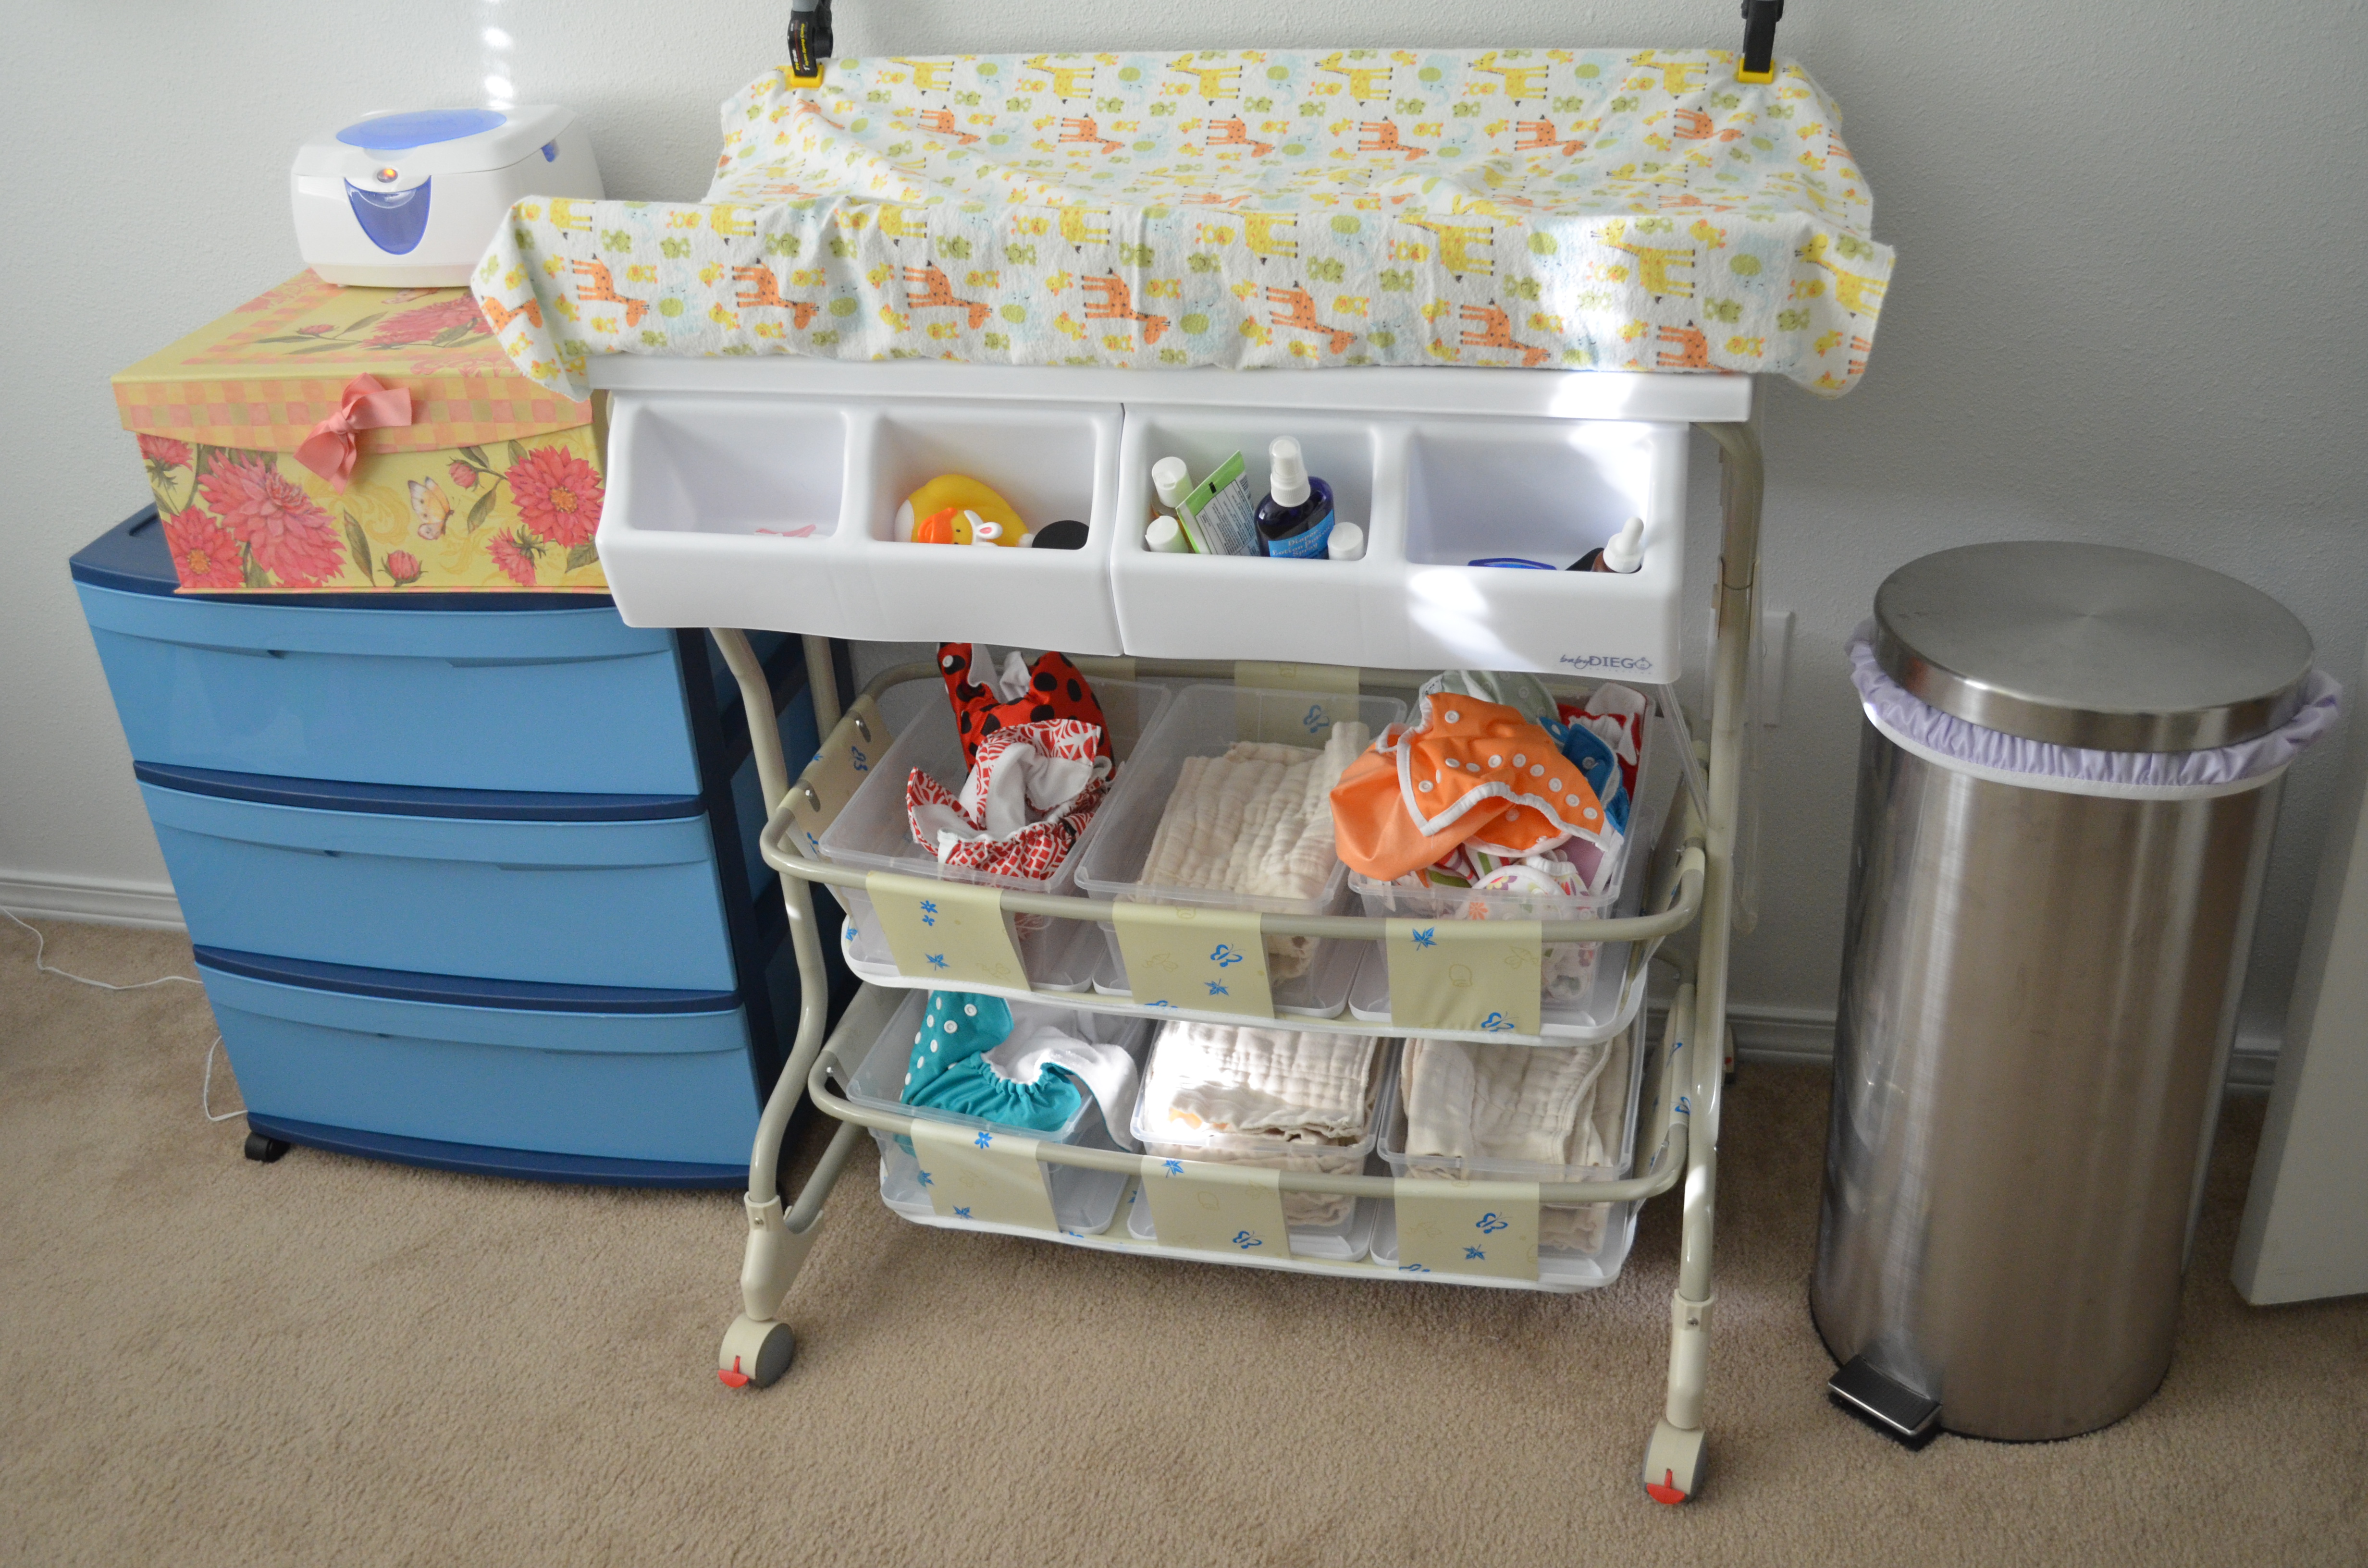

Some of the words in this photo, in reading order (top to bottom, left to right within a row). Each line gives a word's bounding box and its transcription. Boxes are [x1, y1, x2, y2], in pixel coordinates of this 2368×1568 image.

[1288, 529, 1319, 546] Diaper
[1272, 545, 1303, 555] Lotion
[1293, 543, 1318, 557] Spray
